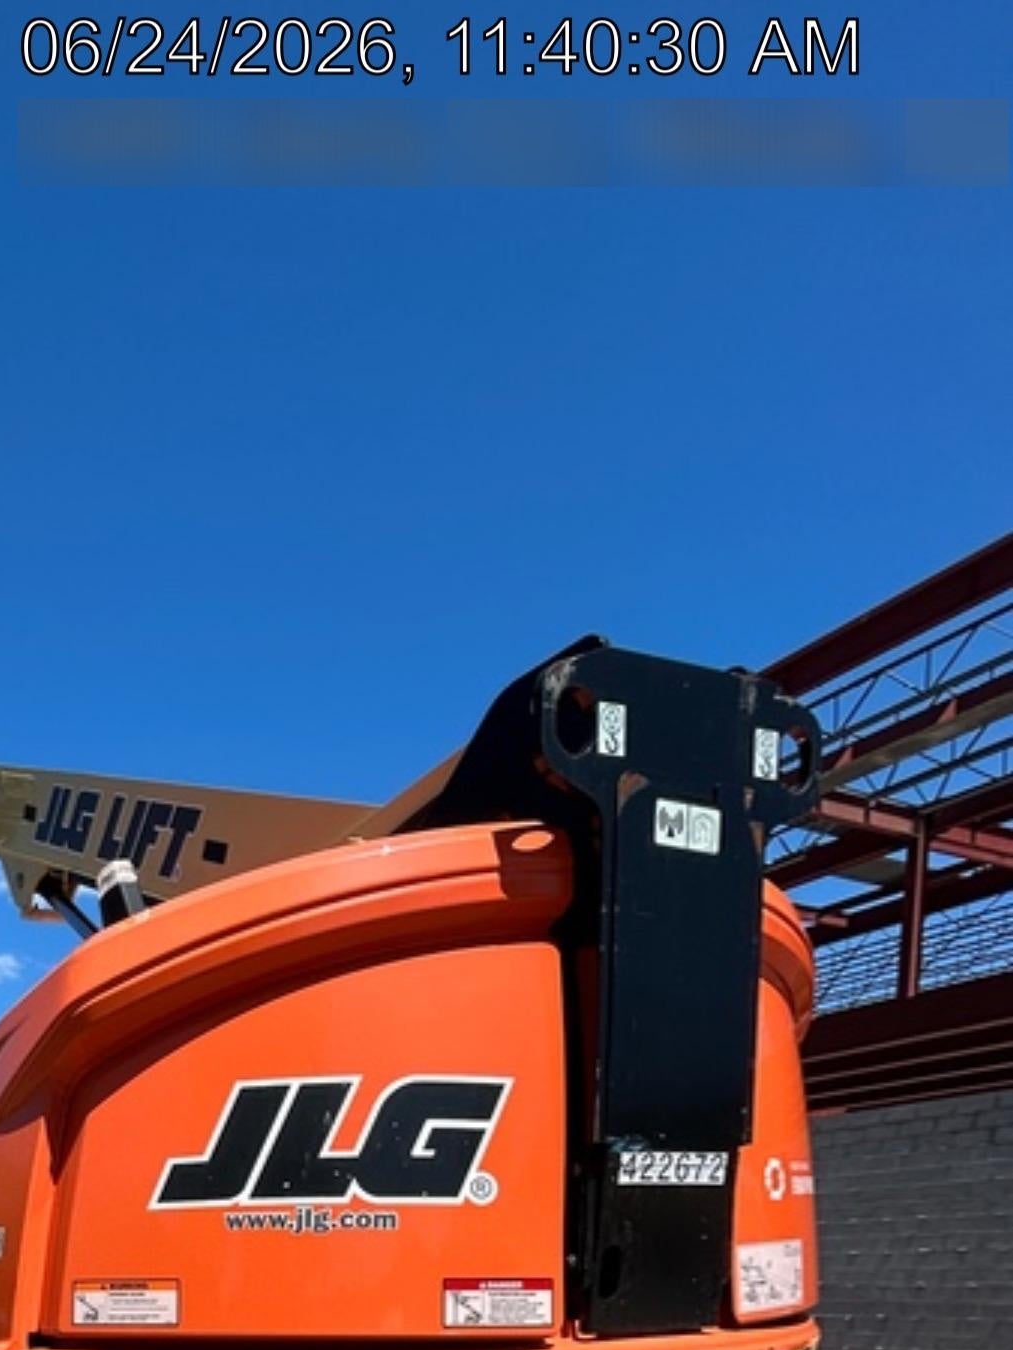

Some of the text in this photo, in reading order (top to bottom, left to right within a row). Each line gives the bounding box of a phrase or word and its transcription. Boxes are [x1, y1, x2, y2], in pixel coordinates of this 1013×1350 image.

[34, 784, 202, 877] JLG LIFT
[225, 1209, 397, 1232] www.jlg.com
